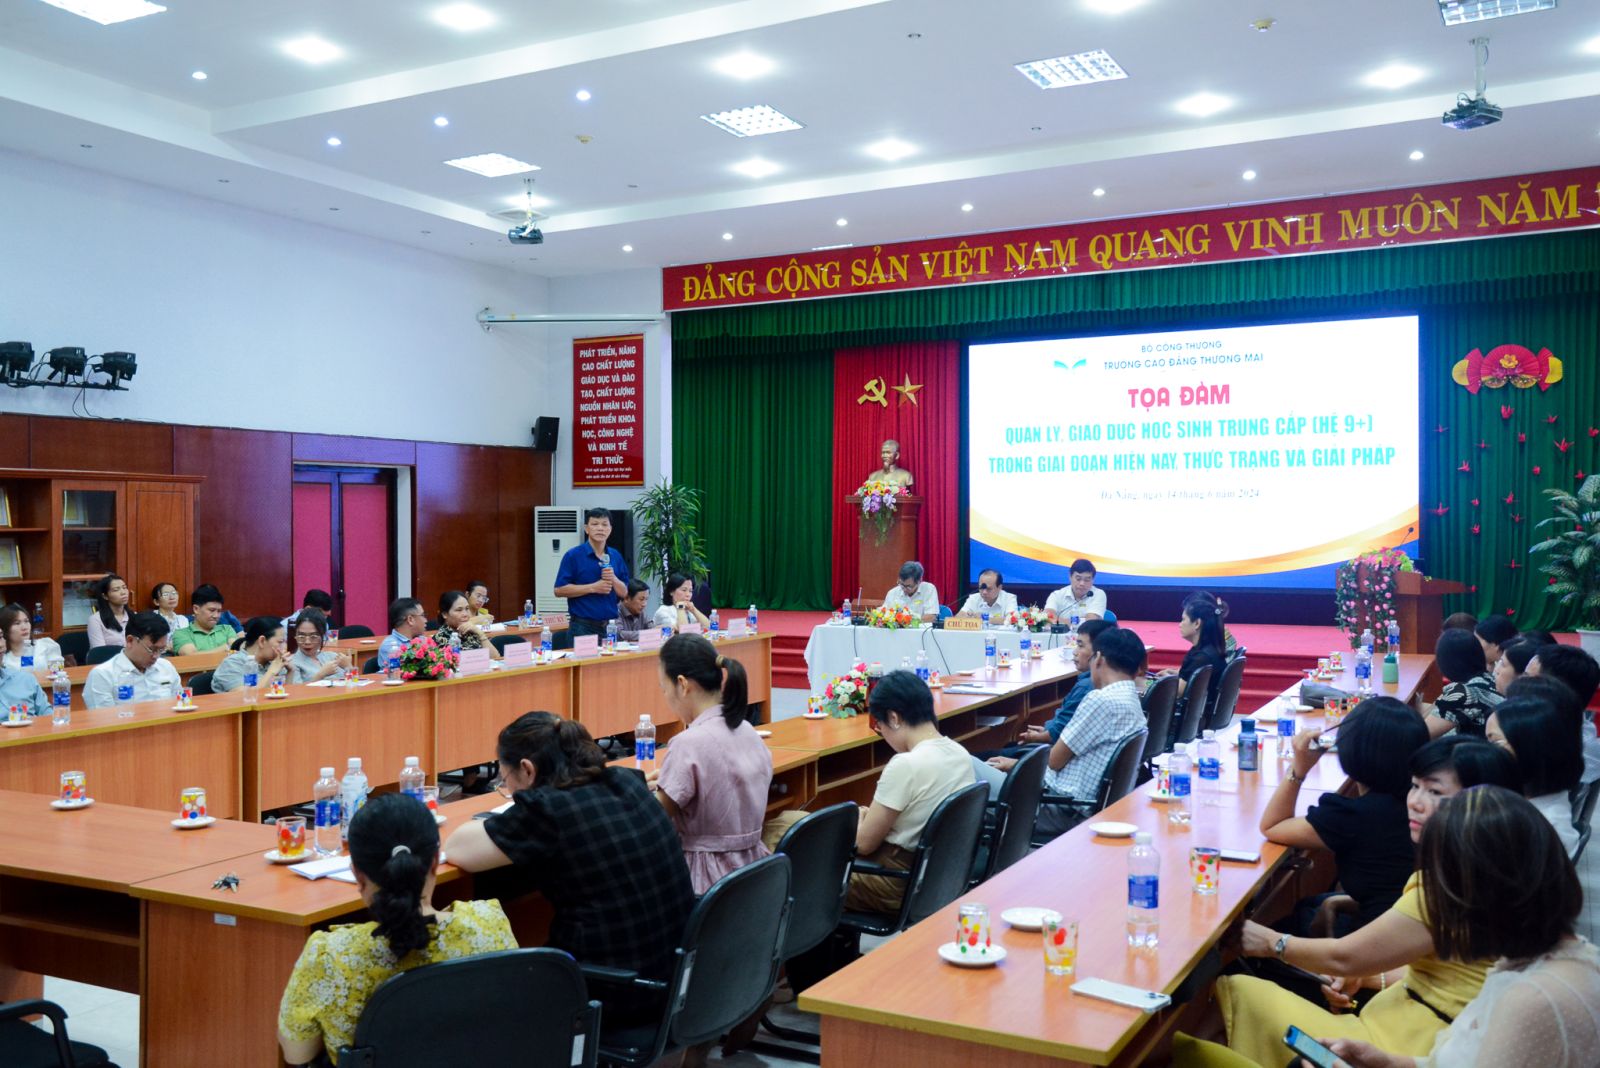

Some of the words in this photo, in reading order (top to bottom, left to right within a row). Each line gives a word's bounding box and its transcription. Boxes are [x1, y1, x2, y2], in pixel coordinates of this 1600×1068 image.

[683, 263, 756, 302] ĐẢNG
[766, 257, 841, 298] CỘNG
[851, 246, 910, 287] SẢN
[919, 241, 994, 282] VIỆT
[1003, 237, 1079, 272] NAM
[1088, 223, 1212, 270] QUANG
[1222, 212, 1324, 252] VINH
[1337, 193, 1462, 241] MUÔN
[1476, 180, 1582, 229] NĂM
[581, 362, 595, 371] CAO
[1144, 358, 1166, 368] CAO
[597, 374, 610, 385] DỤC
[611, 372, 620, 383] VÀ
[1127, 387, 1170, 412] TỌA
[1179, 381, 1230, 407] ĐÀM
[618, 414, 636, 423] KHOA
[1177, 419, 1213, 438] SINH
[1217, 417, 1270, 437] TRUNG
[599, 442, 616, 451] KINH
[592, 456, 603, 465] TRI
[988, 456, 1033, 474] TRONG
[1037, 455, 1066, 473] GIAI
